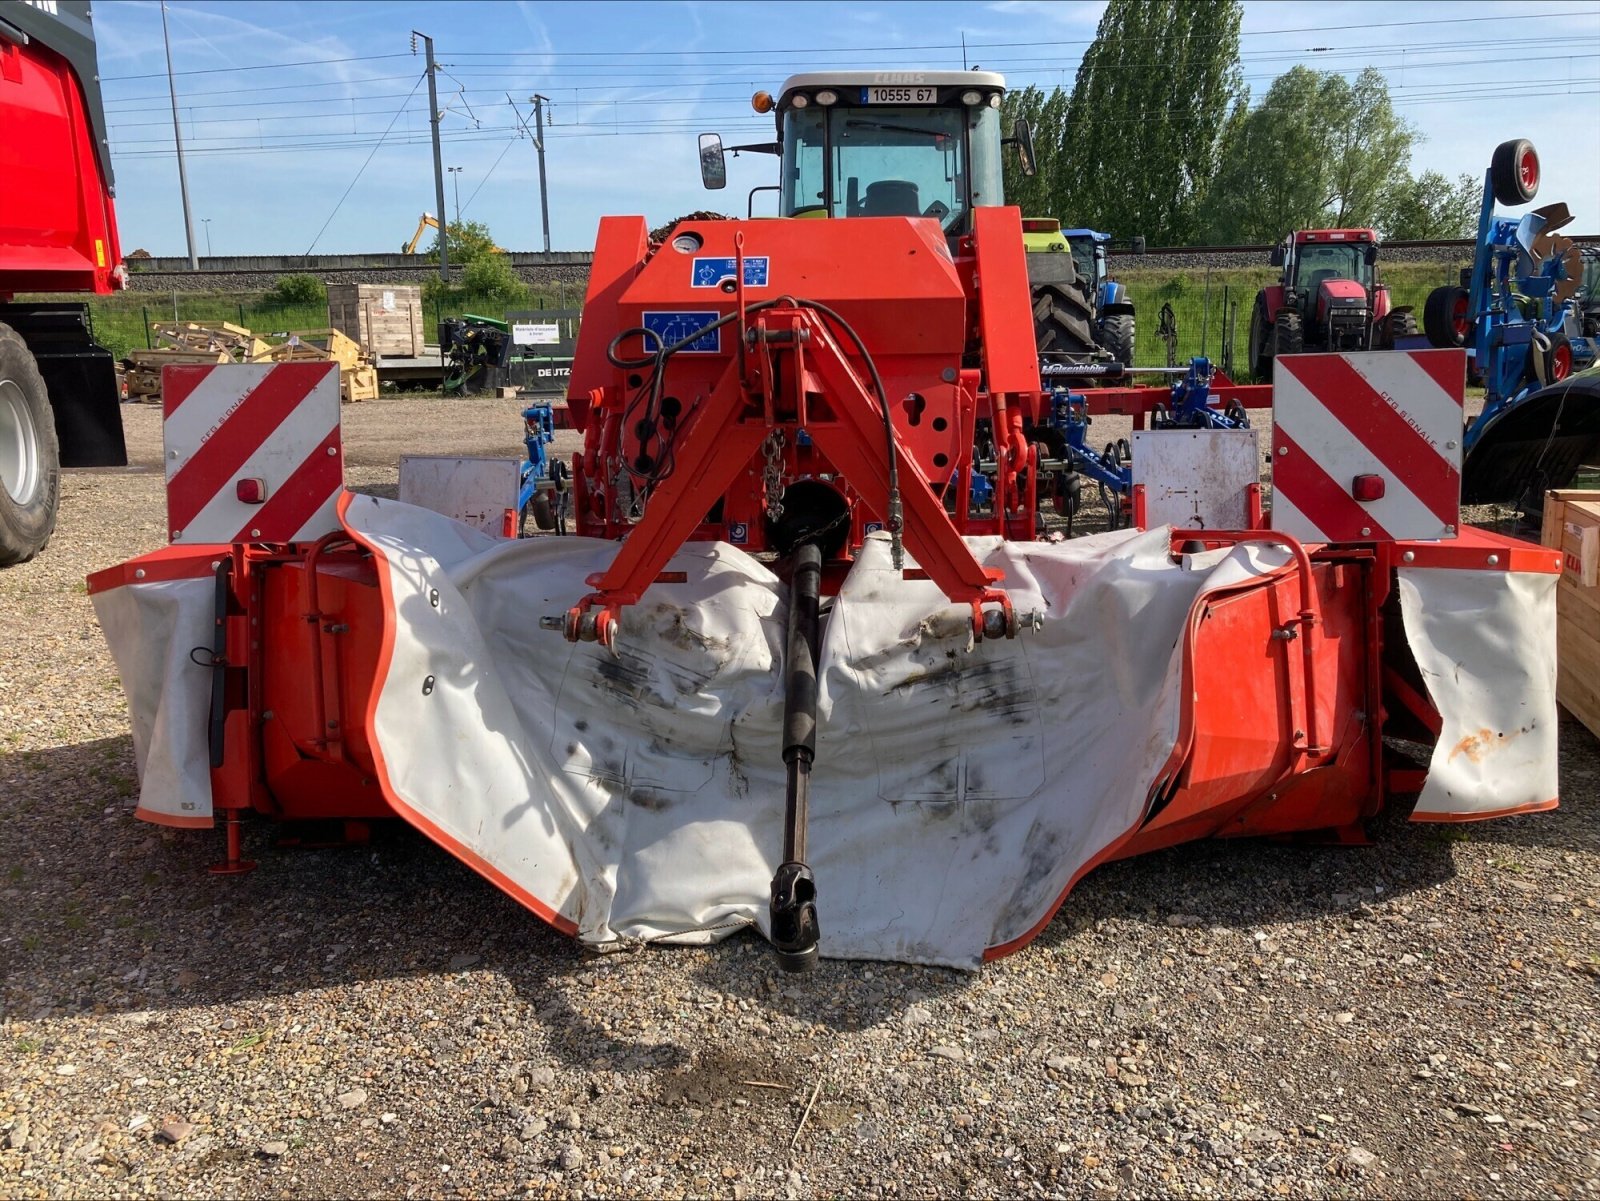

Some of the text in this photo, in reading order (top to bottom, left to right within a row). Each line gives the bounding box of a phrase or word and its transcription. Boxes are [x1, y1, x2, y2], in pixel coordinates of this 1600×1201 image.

[873, 72, 925, 83] CLAAS
[874, 89, 911, 101] 10555
[917, 89, 932, 101] 67
[1380, 391, 1399, 409] CFG
